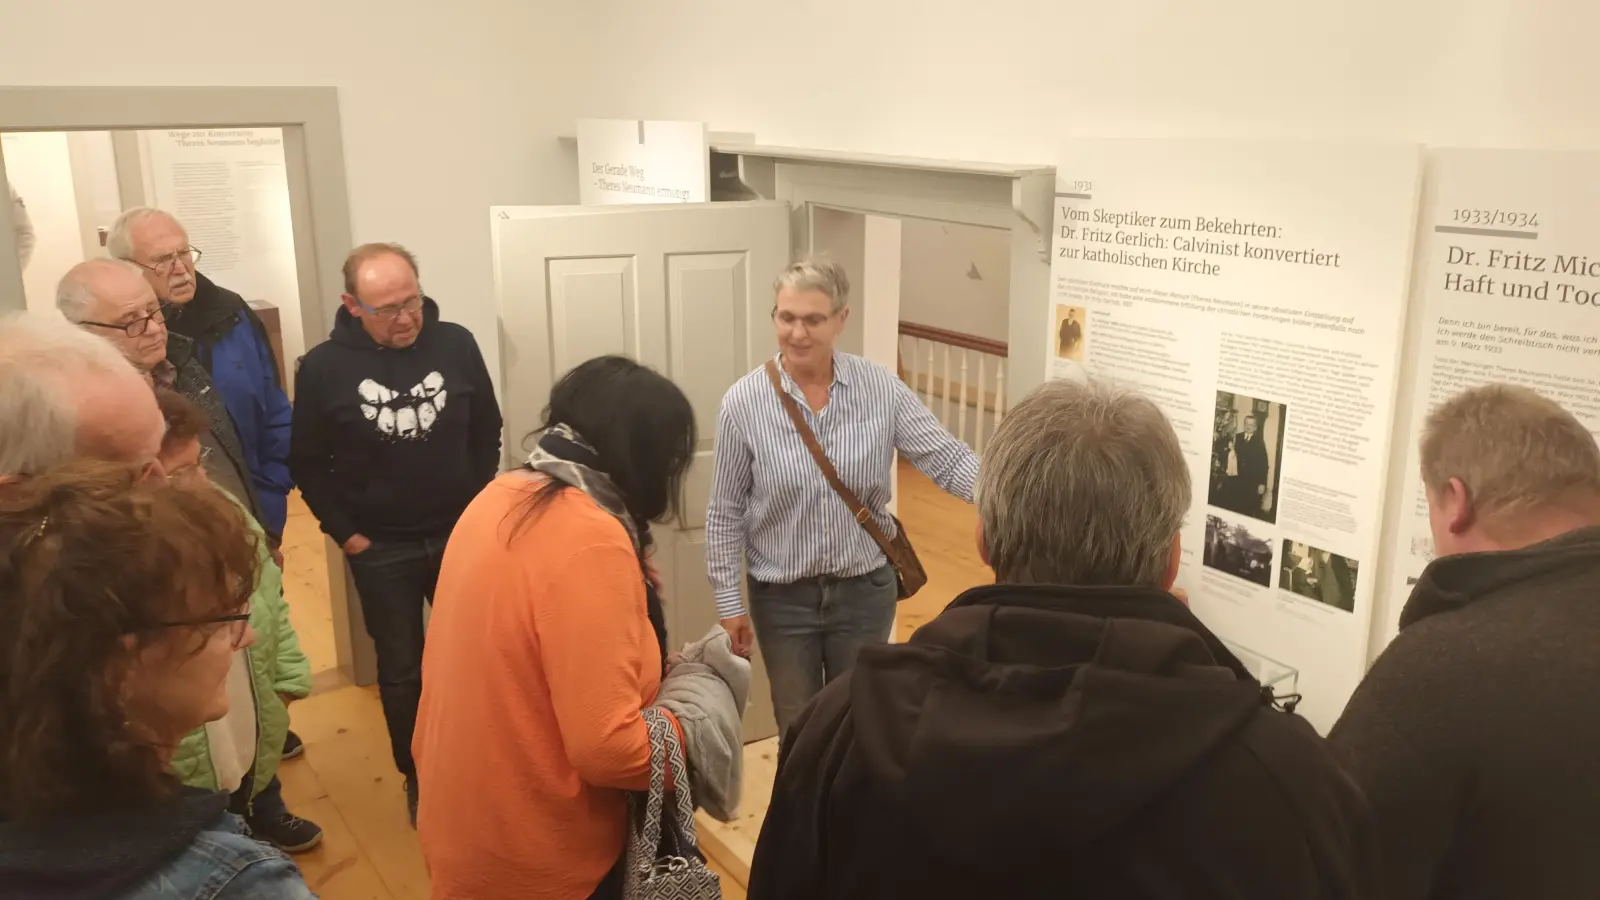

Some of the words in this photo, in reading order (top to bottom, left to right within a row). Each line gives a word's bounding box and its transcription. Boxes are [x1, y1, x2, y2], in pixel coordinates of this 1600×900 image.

[592, 162, 603, 175] Der
[604, 163, 628, 177] Gerade
[628, 165, 645, 181] Weg
[598, 179, 621, 192] Theres
[621, 182, 656, 197] Neumann
[1073, 180, 1093, 192] 1931
[1061, 206, 1090, 222] Vom
[1093, 208, 1157, 229] Skeptiker
[1159, 216, 1192, 231] zum
[1195, 215, 1283, 239] Bekehrten:
[1452, 208, 1540, 229] 1933/1934
[1060, 225, 1079, 240] Dr.
[1082, 227, 1113, 244] Fritz
[1115, 231, 1169, 250] Gerlich:
[1172, 235, 1241, 258] Calvinist
[1243, 241, 1341, 268] konvertiert
[1446, 245, 1480, 267] Dr.
[1486, 248, 1548, 273] Fritz
[1059, 246, 1080, 260] zur
[1082, 245, 1168, 271] katholischen
[1171, 256, 1221, 277] Kirche
[1443, 271, 1497, 296] Haft
[1501, 280, 1550, 301] und
[1438, 316, 1460, 326] Denn
[1462, 318, 1475, 329] ich
[1477, 321, 1492, 331] bin
[1562, 333, 1581, 343] was
[1583, 334, 1598, 344] ich
[1451, 329, 1478, 340] werde
[1479, 332, 1496, 343] den
[1498, 334, 1554, 350] Schreibtisch
[1555, 342, 1581, 354] nicht
